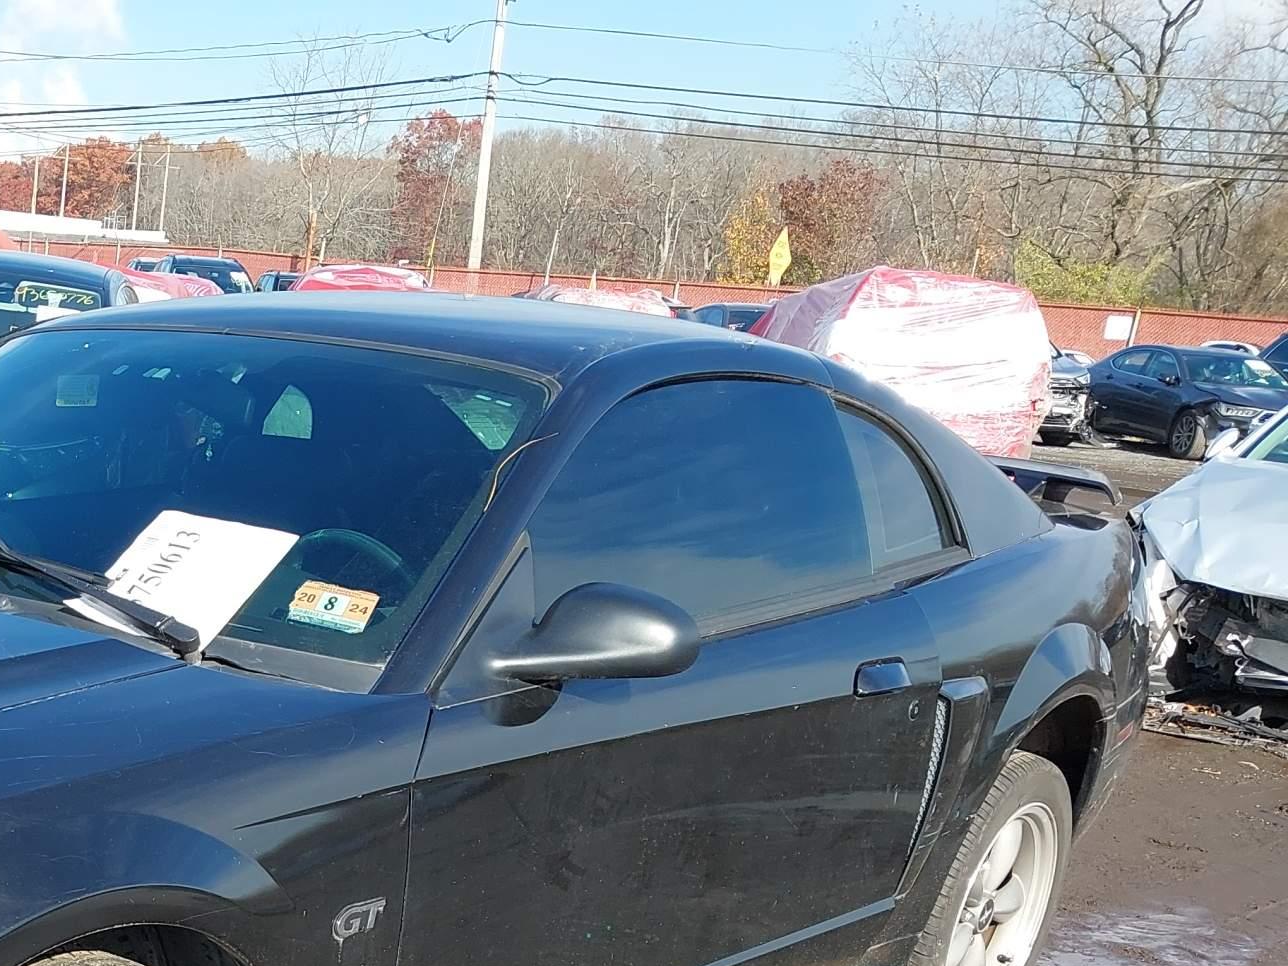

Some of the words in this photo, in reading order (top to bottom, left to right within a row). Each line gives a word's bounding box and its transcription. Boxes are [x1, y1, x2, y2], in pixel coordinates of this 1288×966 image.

[127, 529, 201, 604] 750613
[297, 592, 316, 604] 20
[323, 596, 339, 611] 8
[348, 603, 369, 616] 24
[332, 896, 387, 941] GT
